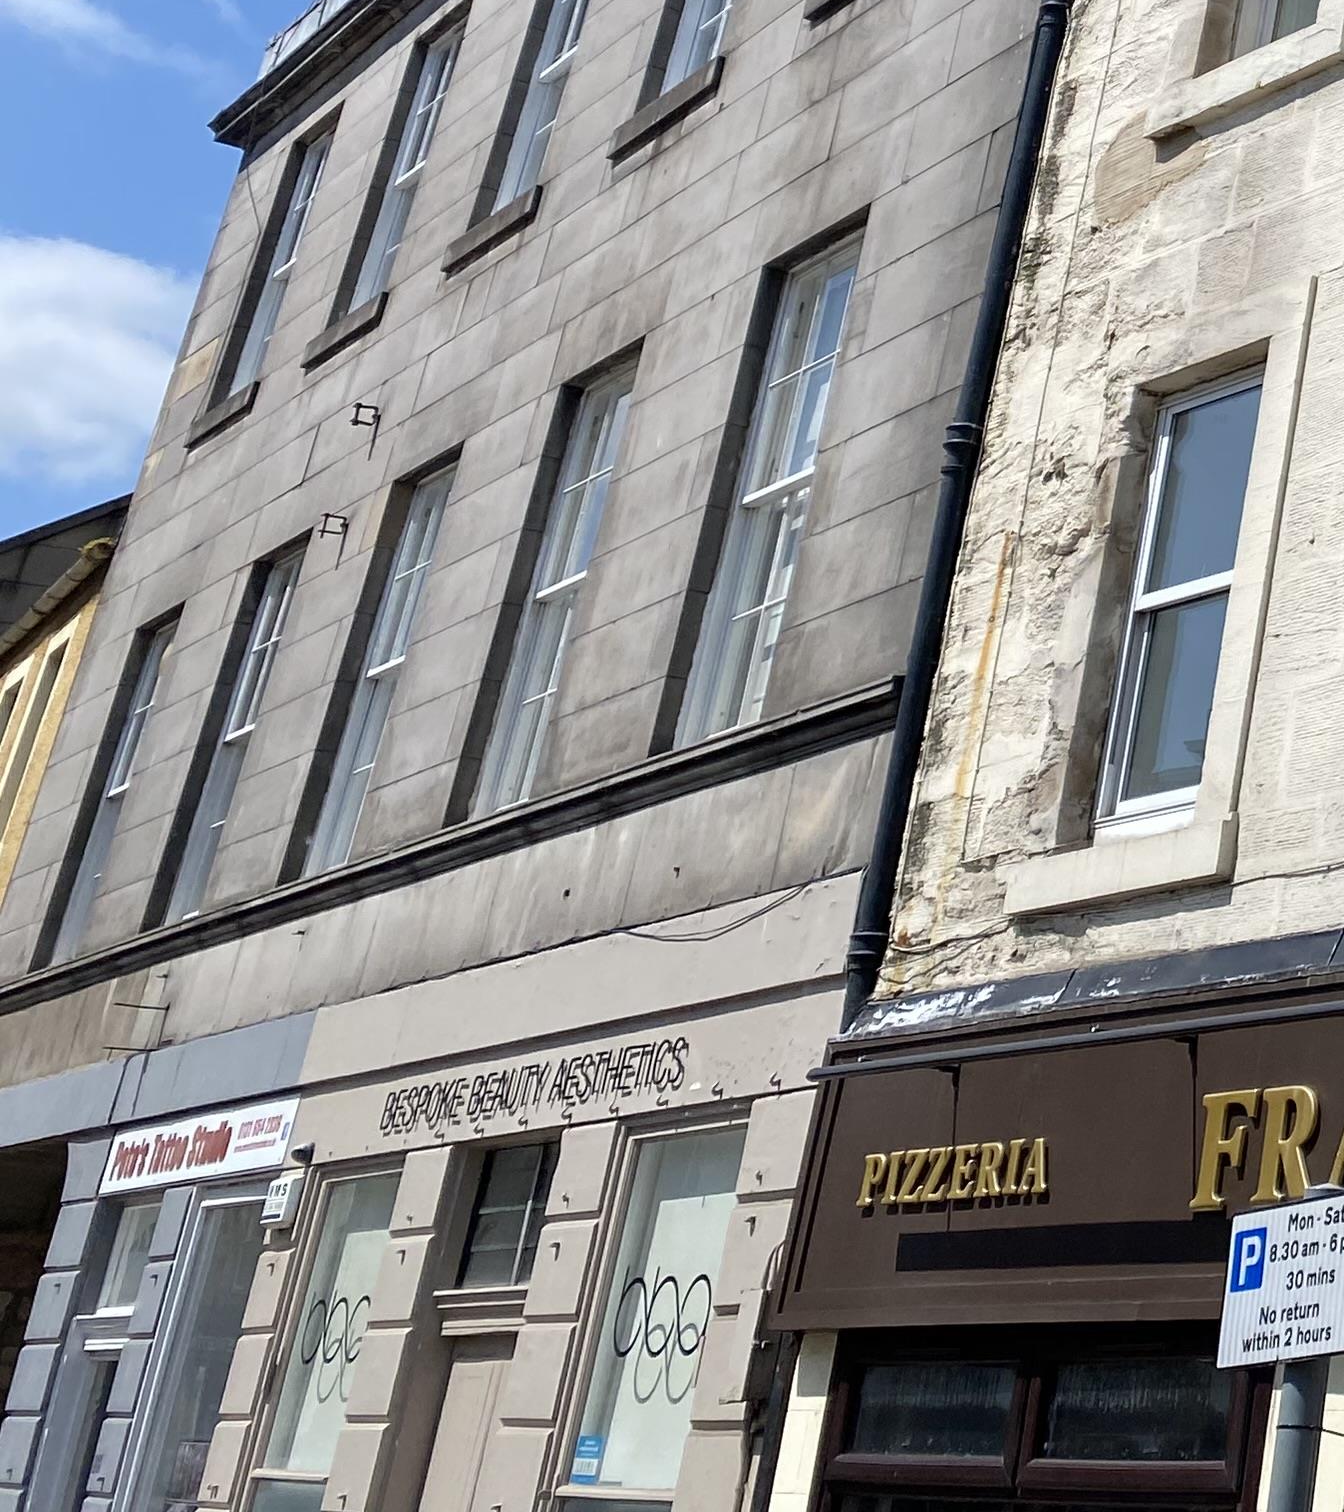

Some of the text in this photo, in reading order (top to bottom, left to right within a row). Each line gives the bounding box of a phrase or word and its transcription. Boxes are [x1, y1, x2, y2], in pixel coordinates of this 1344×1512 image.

[380, 1037, 689, 1133] BESPOKE BEAUTY AESTHETICS
[147, 1133, 189, 1175] Tattoo
[187, 1120, 233, 1169] Studio
[856, 1137, 1048, 1207] PIZZERIA
[1288, 1213, 1314, 1232] Mon
[1238, 1235, 1262, 1286] P
[1269, 1240, 1299, 1263] 8.30
[1301, 1240, 1319, 1257] am
[1329, 1233, 1337, 1252] 6
[1286, 1267, 1336, 1290] 30 mins
[1259, 1303, 1320, 1326] No return
[1242, 1325, 1332, 1352] within 2 hours
